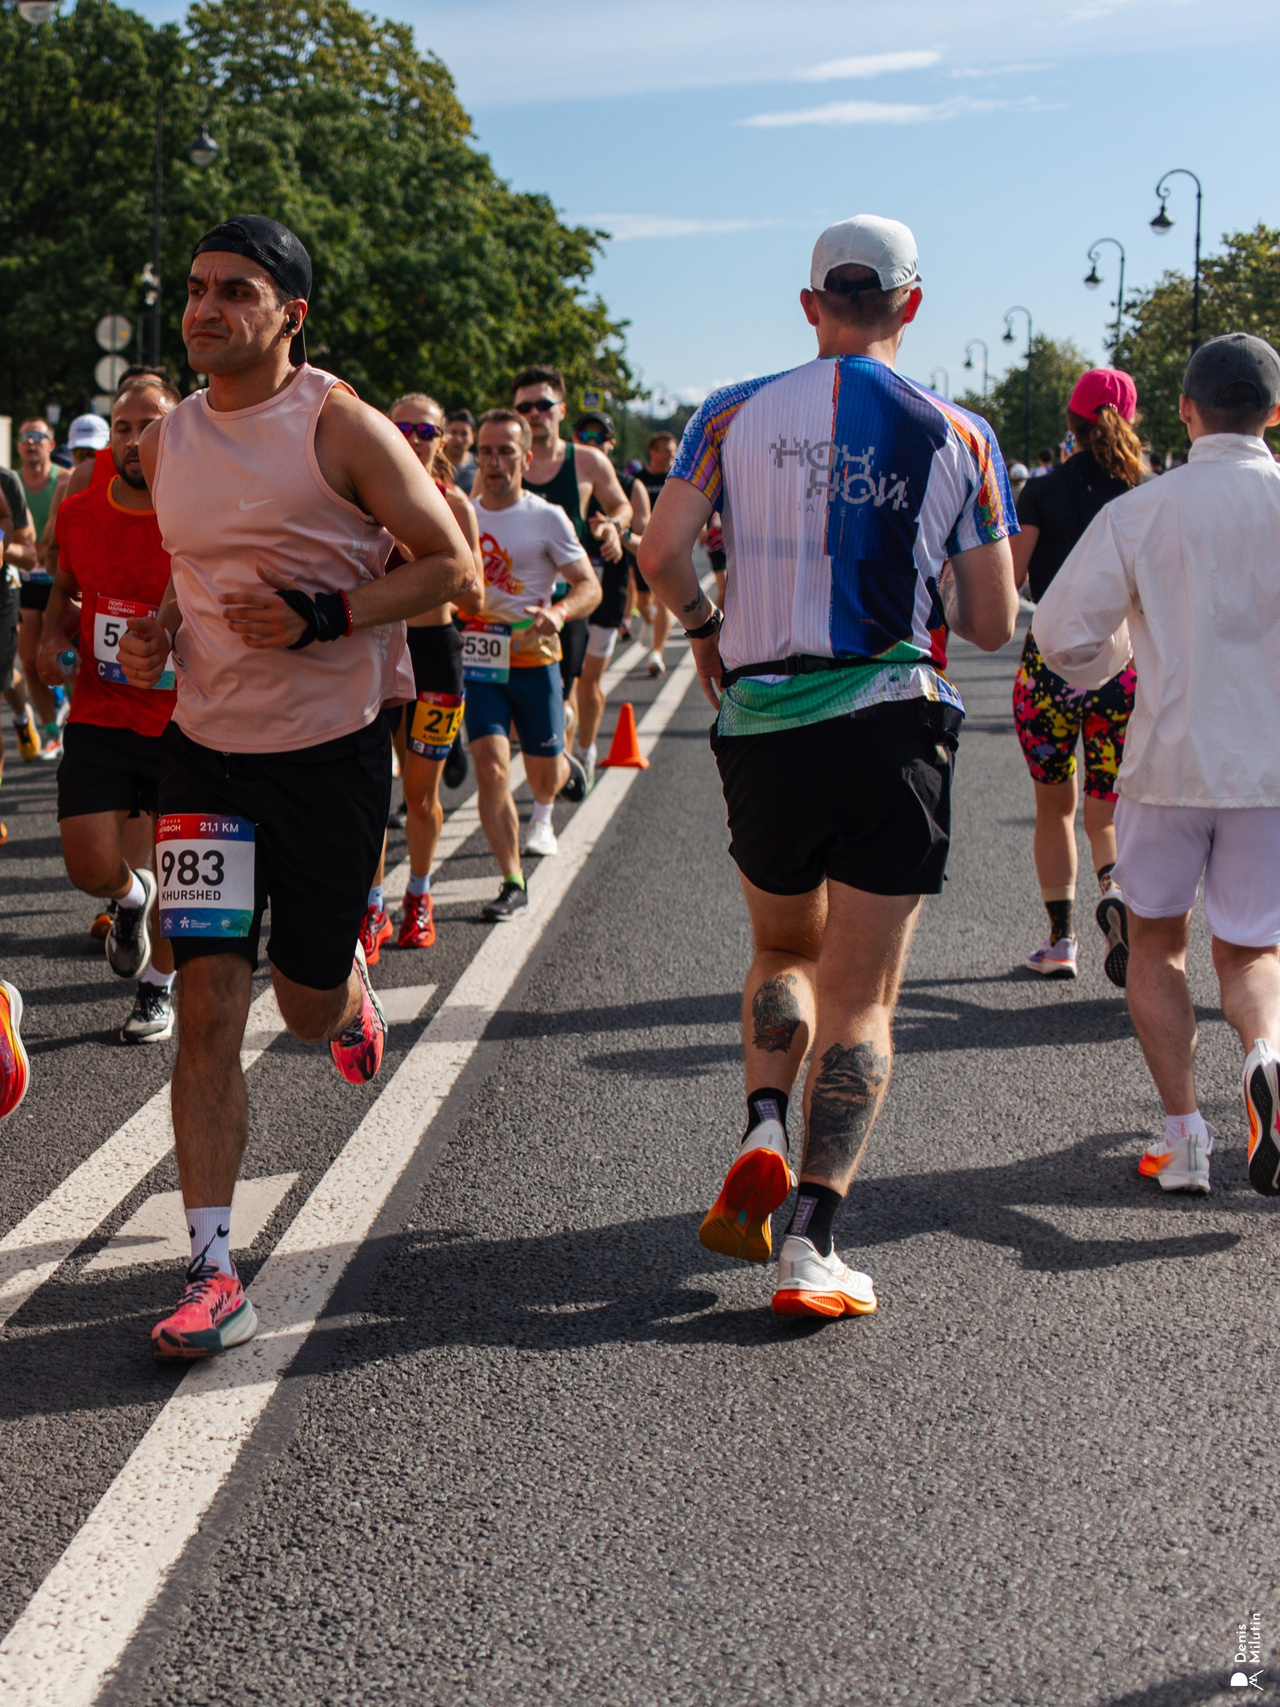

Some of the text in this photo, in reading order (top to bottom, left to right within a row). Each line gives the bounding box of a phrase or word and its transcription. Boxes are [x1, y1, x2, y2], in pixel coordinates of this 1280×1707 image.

[199, 822, 218, 833] 21,1
[161, 849, 225, 887] 983
[161, 890, 221, 902] KHURSHED
